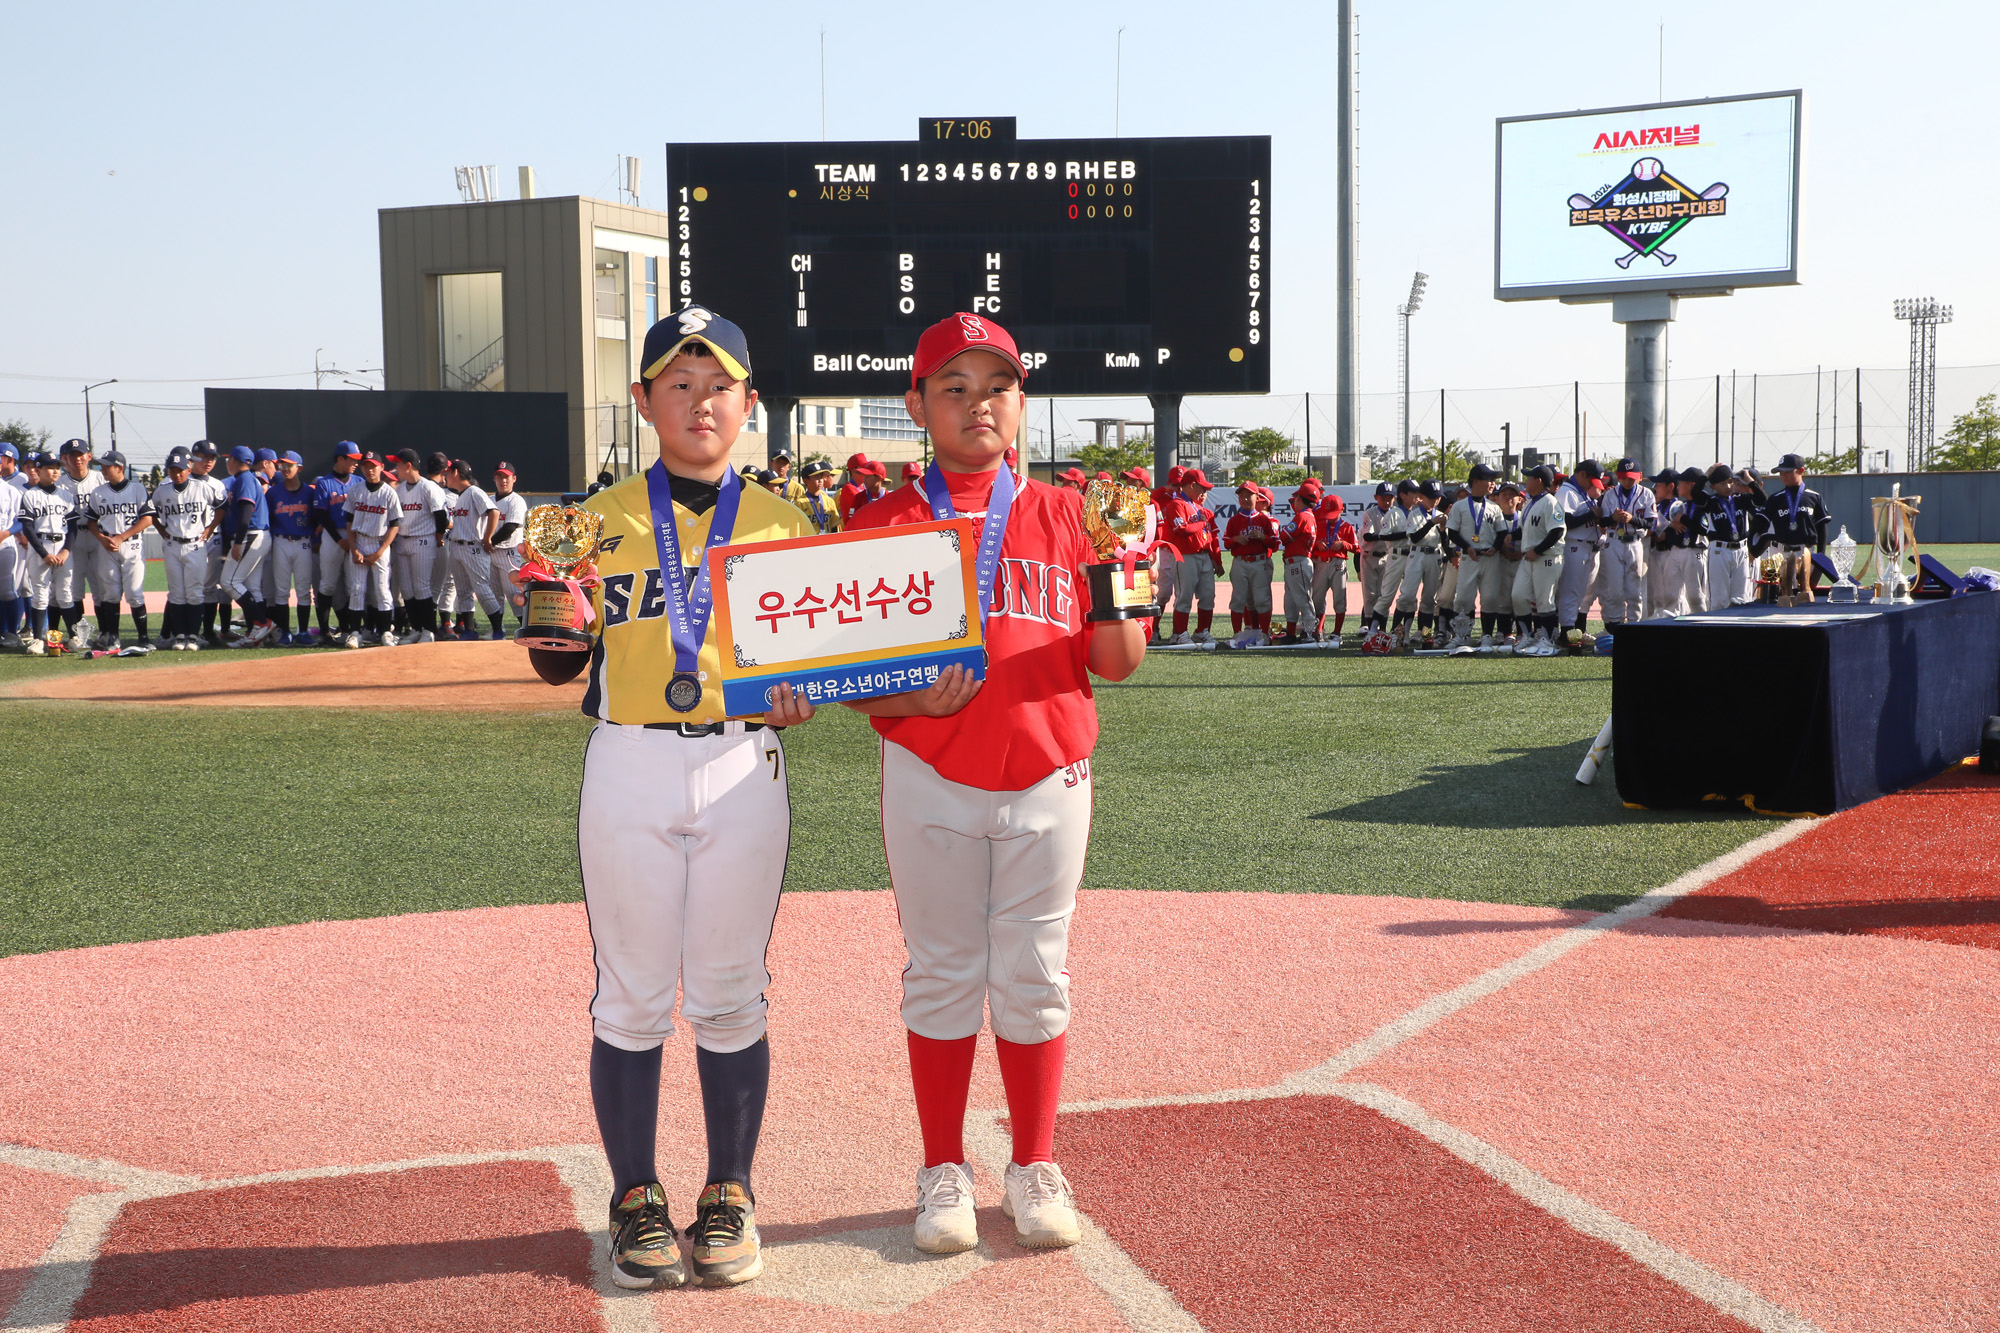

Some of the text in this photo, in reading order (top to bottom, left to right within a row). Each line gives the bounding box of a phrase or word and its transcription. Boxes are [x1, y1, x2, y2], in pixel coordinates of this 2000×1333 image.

[934, 120, 992, 140] 17:06
[1593, 124, 1700, 150] 시사저널
[815, 164, 876, 182] TEAM
[900, 161, 1057, 182] 1 2 3 4 5 6 7 8 9
[679, 186, 688, 203] 1
[819, 185, 870, 201] 시상식
[1250, 180, 1260, 196] 1
[1590, 182, 1612, 202] 2024
[1249, 198, 1261, 215] 2
[1612, 189, 1681, 207] 화성시장배
[678, 205, 690, 221] 2
[1570, 199, 1726, 225] 전국유소년야구대회
[678, 224, 690, 240] 3
[1249, 217, 1260, 233] 3
[1626, 221, 1671, 236] KYBF
[678, 243, 690, 258] 4
[1249, 235, 1261, 252] 4
[680, 261, 691, 277] 5
[791, 254, 812, 272] CH
[900, 253, 914, 271] B
[986, 252, 1001, 270] H
[1249, 254, 1260, 271] 5
[680, 280, 691, 295] 6
[900, 275, 914, 292] S
[986, 274, 1000, 291] E
[1249, 273, 1260, 289] 6
[899, 297, 915, 314] O
[973, 296, 1001, 313] FC
[1249, 291, 1261, 308] 7
[678, 307, 713, 336] S
[1249, 310, 1260, 326] 8
[960, 315, 989, 341] S
[1249, 328, 1260, 345] 9
[813, 354, 852, 371] Ball
[1105, 352, 1140, 368] Km/h
[1158, 348, 1171, 365] P
[164, 501, 203, 516] DAECHI
[354, 501, 386, 515] Giants
[401, 502, 423, 511] ants
[191, 514, 198, 524] 3
[1530, 515, 1542, 527] W
[661, 522, 689, 634] 2024 화성시장배 전국유소년야구대회
[755, 570, 936, 634] 우수선수상
[765, 746, 779, 782] 7
